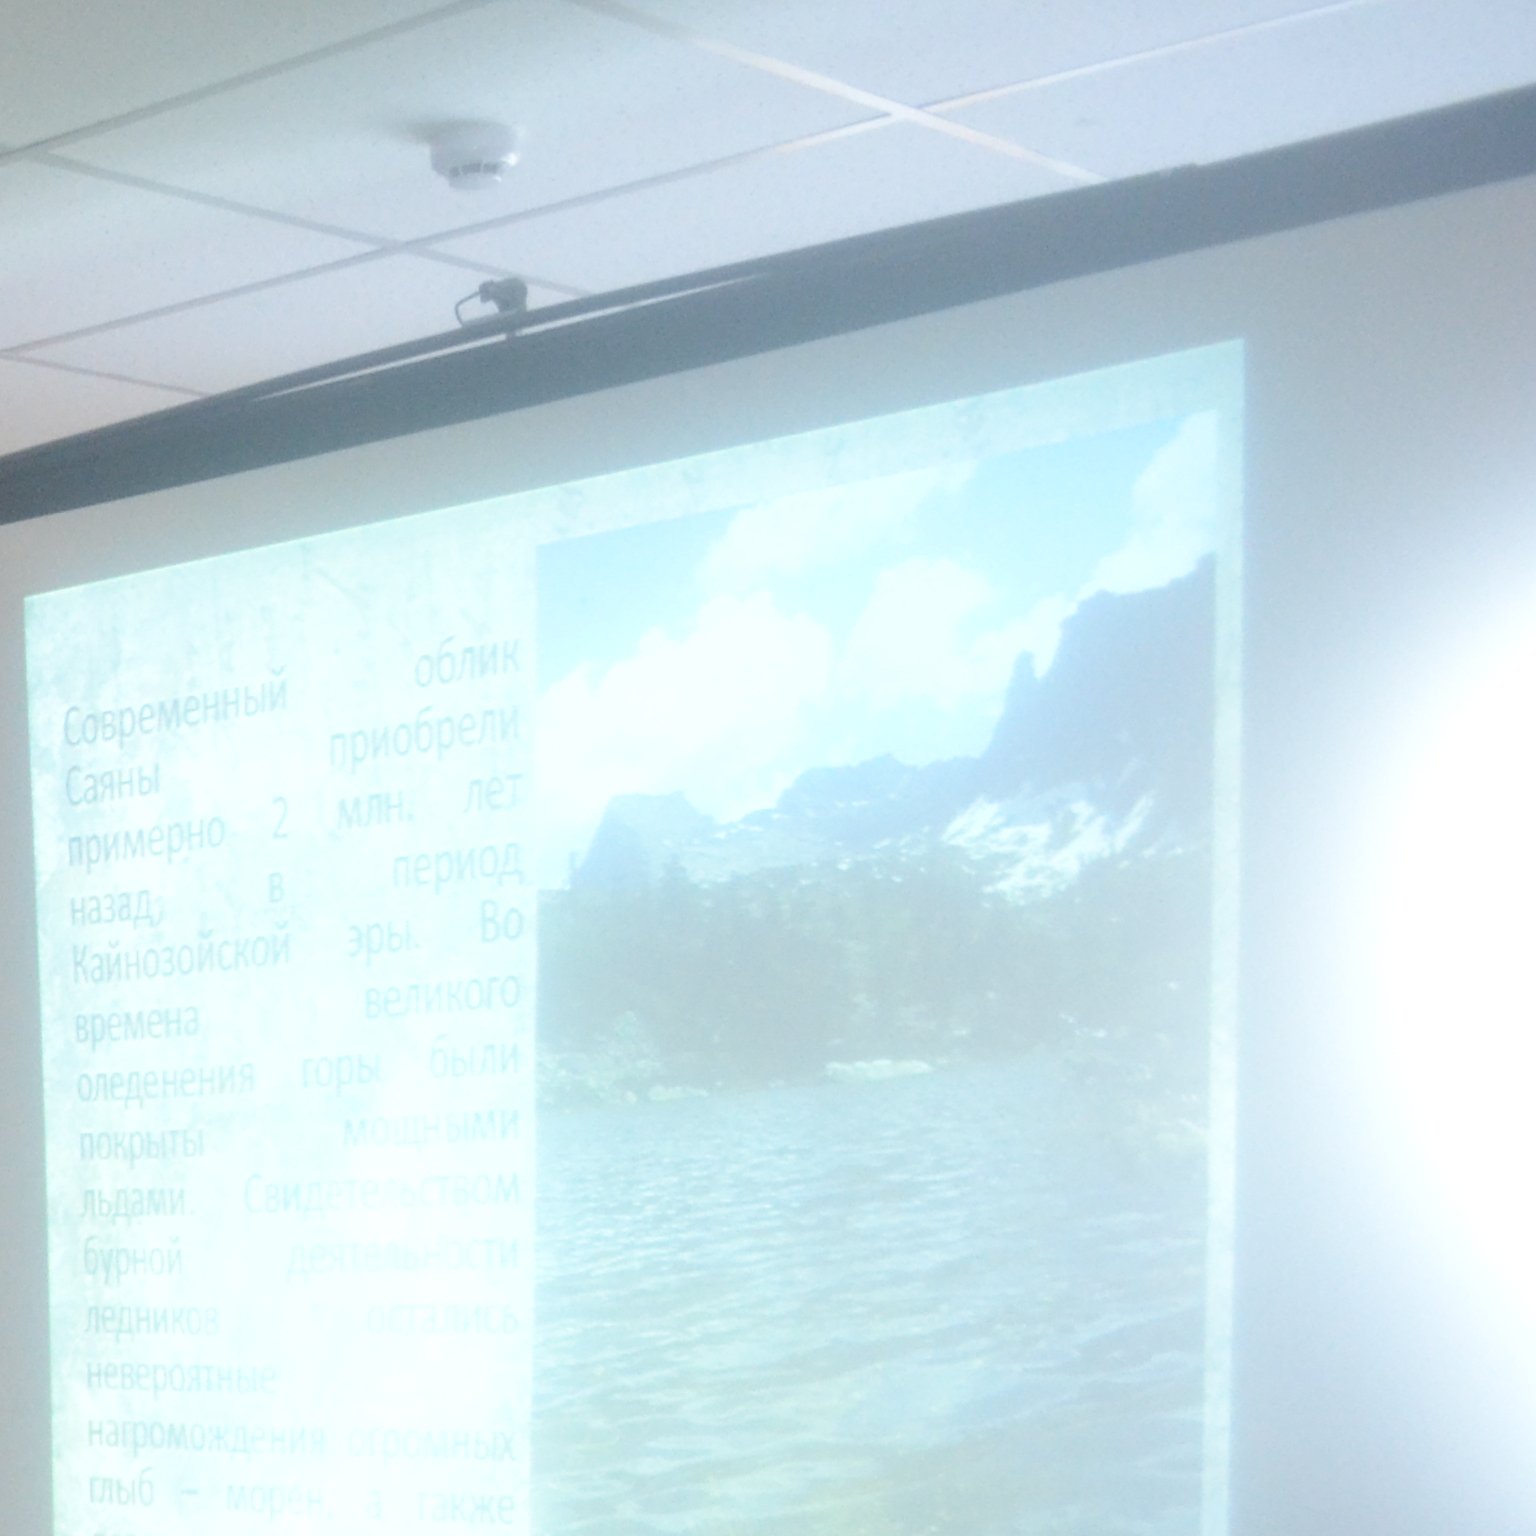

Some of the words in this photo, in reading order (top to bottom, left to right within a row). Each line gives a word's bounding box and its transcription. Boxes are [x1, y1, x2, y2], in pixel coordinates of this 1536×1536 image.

[63, 666, 289, 747] Современный
[414, 635, 521, 691] облик
[65, 761, 161, 807] Саяны
[329, 704, 521, 776] приобрели
[68, 813, 225, 874] примерно
[271, 797, 289, 840] 2
[337, 787, 414, 830] млн.
[463, 771, 525, 815] лет
[71, 888, 163, 927] назад,
[269, 872, 284, 904] в
[392, 841, 525, 898] период
[73, 921, 291, 985] Кайнозойской
[348, 914, 420, 965] эры.
[480, 898, 525, 943] Во
[75, 1003, 201, 1053] времена
[365, 973, 522, 1020] великого
[77, 1060, 255, 1107] оледенения
[302, 1051, 381, 1096] горы
[429, 1034, 520, 1079] были
[79, 1128, 205, 1168] покрыты
[343, 1109, 520, 1152] мощными
[81, 1183, 196, 1225] льдами.
[243, 1171, 521, 1220] Свидетельством
[83, 1235, 184, 1288] бурной
[287, 1236, 520, 1283] деятельности
[85, 1301, 220, 1342] ледников
[366, 1300, 520, 1336] остались
[87, 1362, 277, 1402] невероятные
[88, 1420, 325, 1461] нагромождения
[349, 1425, 517, 1464] огромных
[89, 1466, 155, 1506] глыб
[227, 1479, 334, 1522] морен,
[366, 1489, 383, 1520] а
[417, 1488, 515, 1526] также
